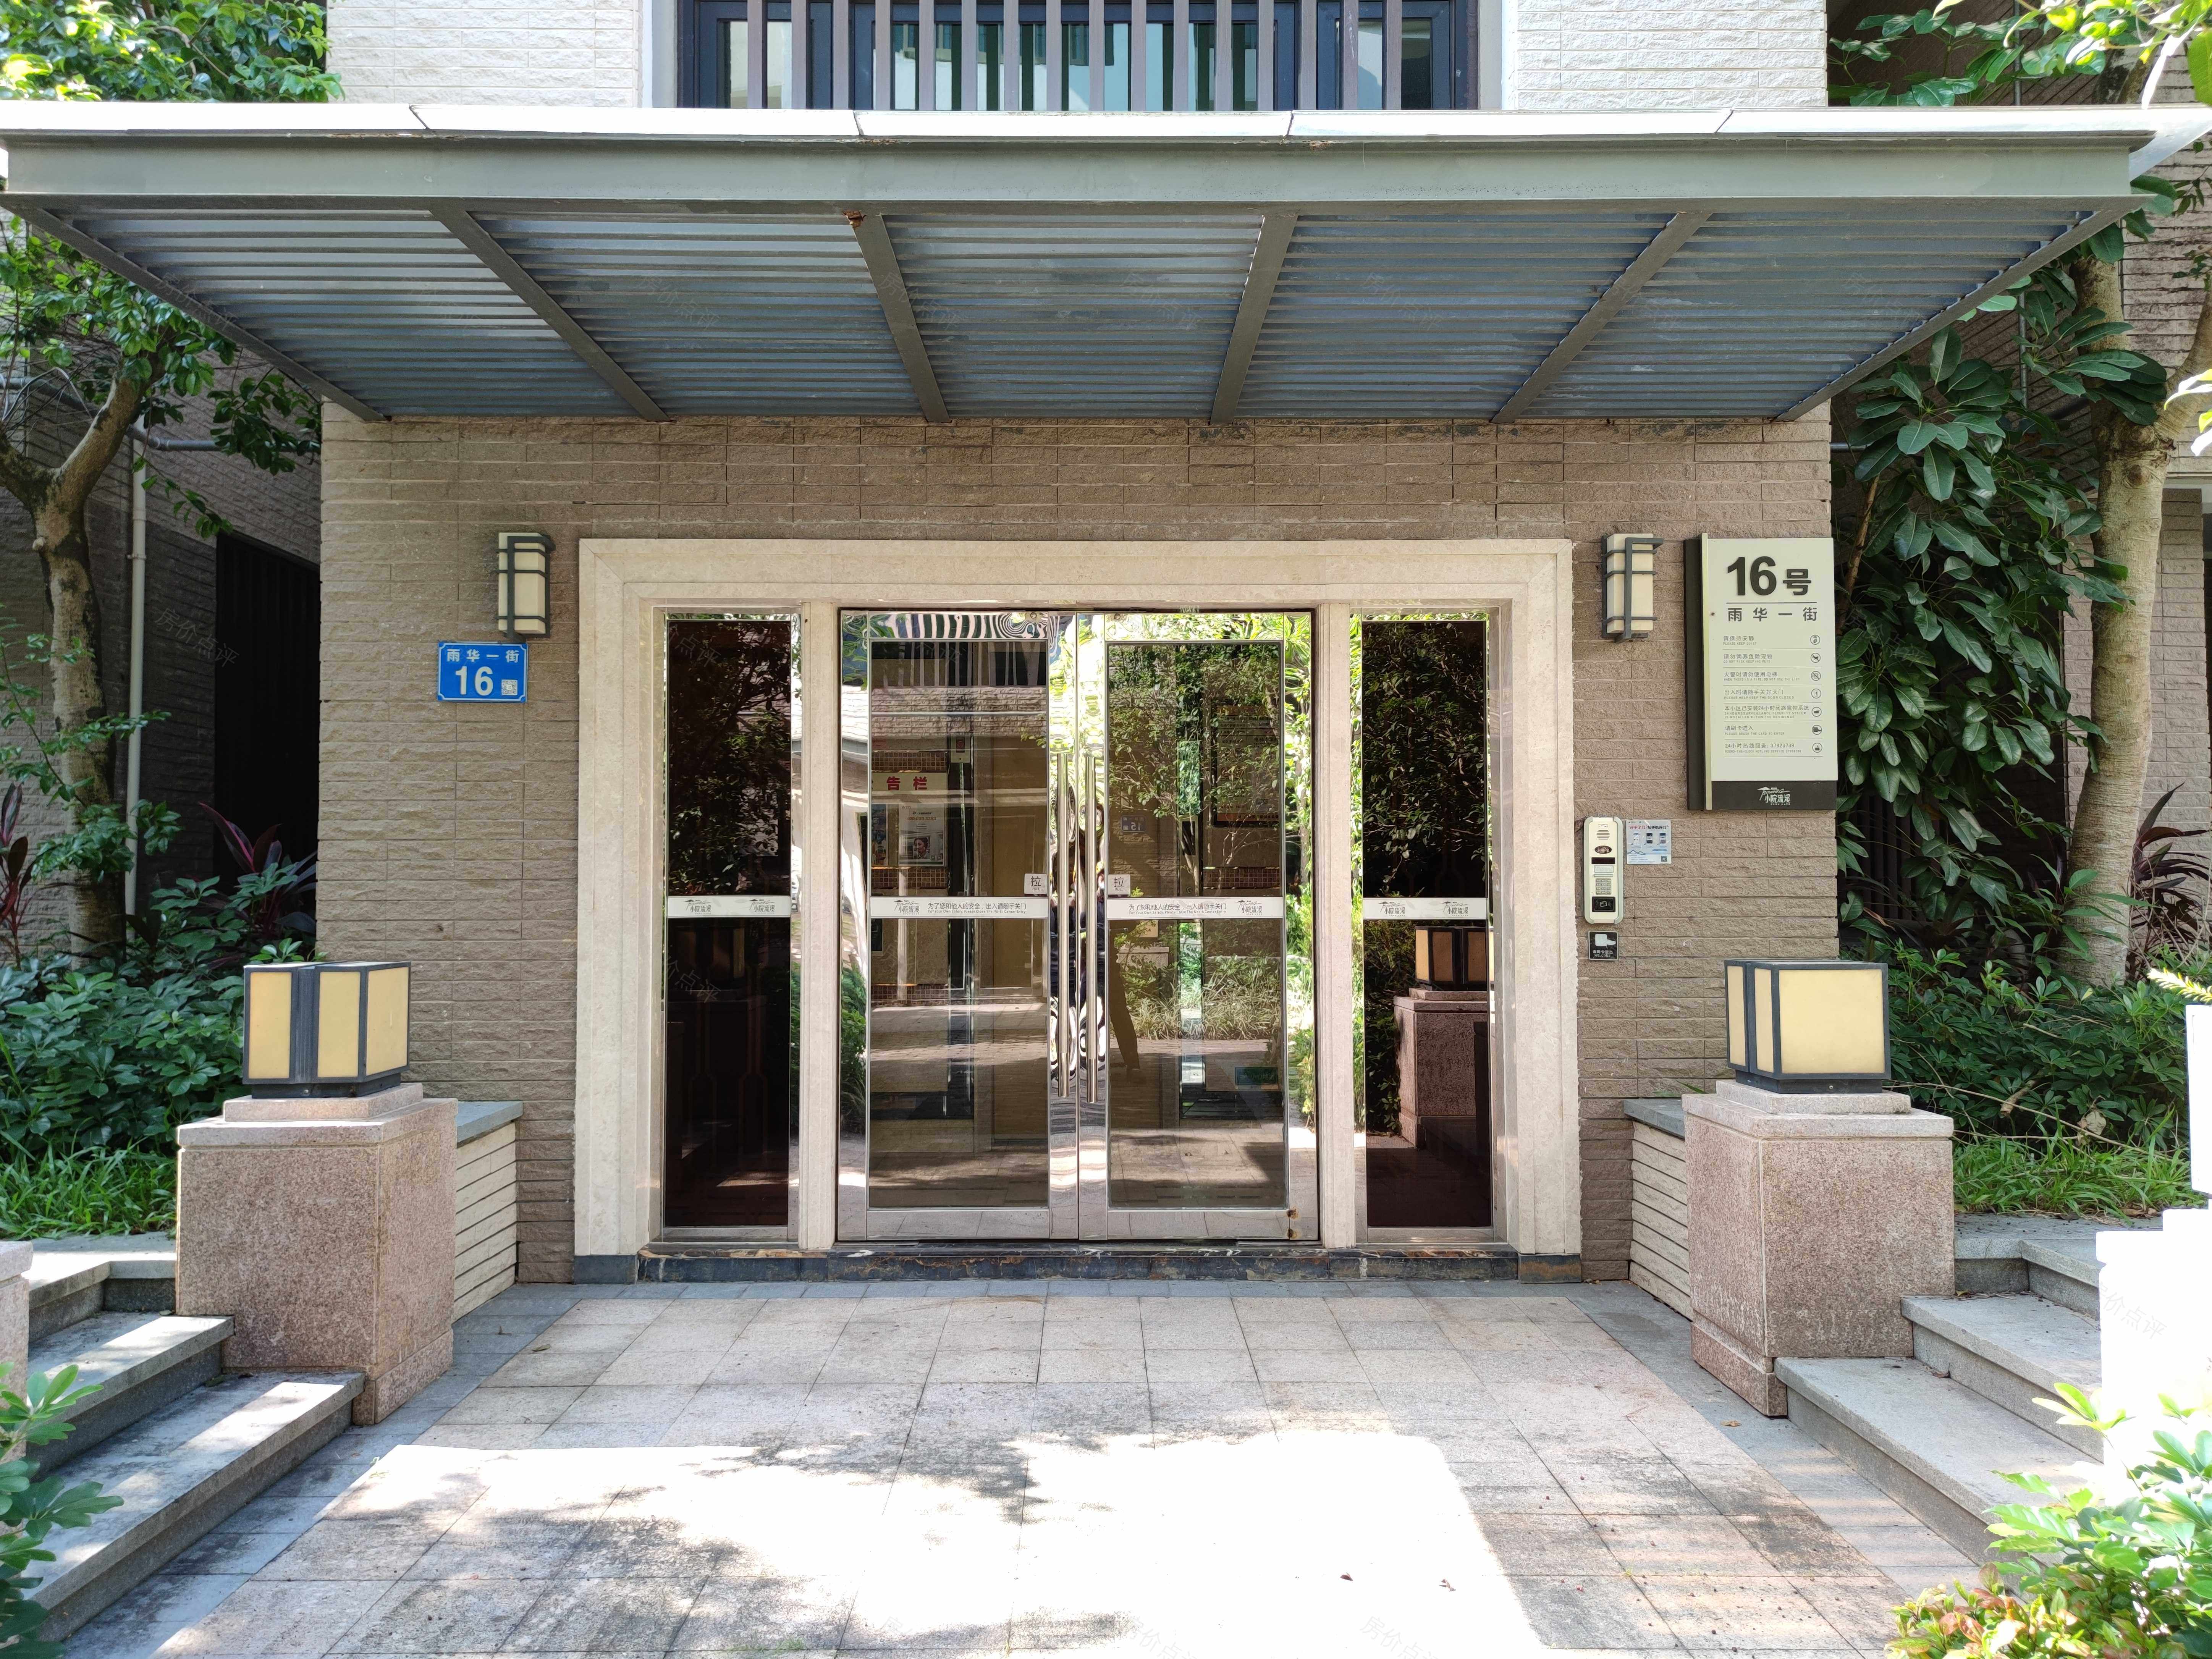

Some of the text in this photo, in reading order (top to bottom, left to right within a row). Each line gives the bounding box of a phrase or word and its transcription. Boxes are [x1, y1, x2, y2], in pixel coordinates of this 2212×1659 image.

[1727, 556, 1811, 595] 16号
[1727, 607, 1817, 621] 雨华一街
[447, 649, 519, 663] 雨华一街
[455, 666, 493, 696] 16
[872, 776, 927, 790] 告栏
[1764, 794, 1790, 803] 小院流溪
[1030, 876, 1041, 886] 拉
[1114, 876, 1125, 887] 拉
